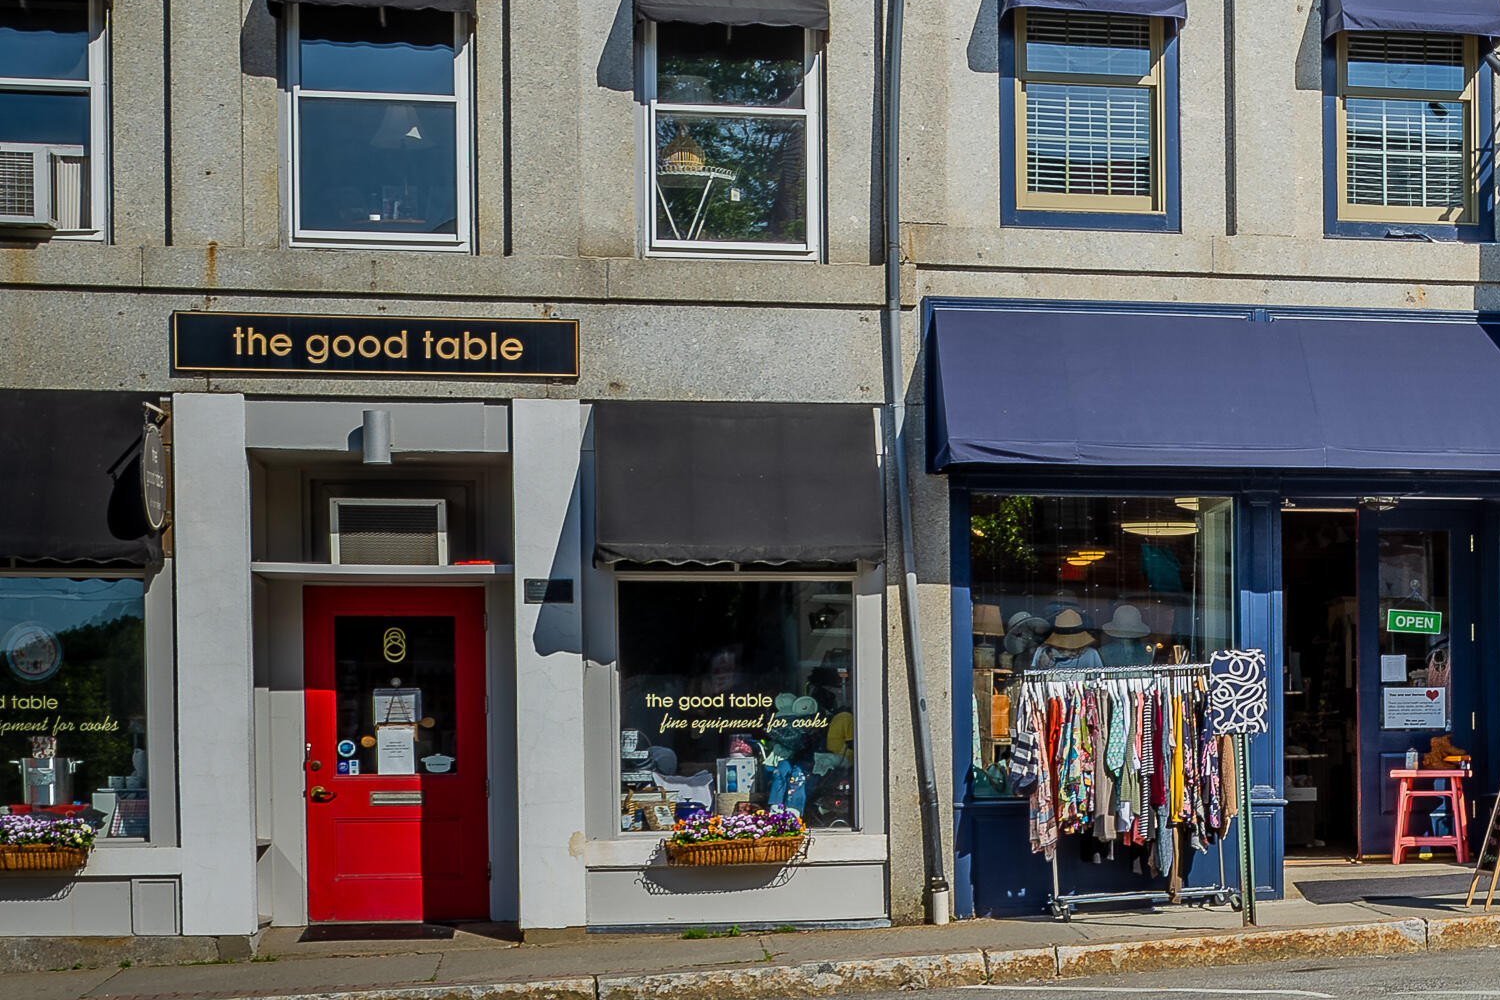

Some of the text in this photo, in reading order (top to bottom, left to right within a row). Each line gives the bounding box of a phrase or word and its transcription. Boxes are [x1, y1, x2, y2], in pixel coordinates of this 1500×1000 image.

[232, 326, 524, 364] the good table
[1395, 615, 1434, 629] OPEN
[11, 695, 59, 710] table
[645, 693, 773, 711] the good table
[0, 716, 120, 737] pment for cooks
[659, 712, 829, 734] fine equipment for cooks
